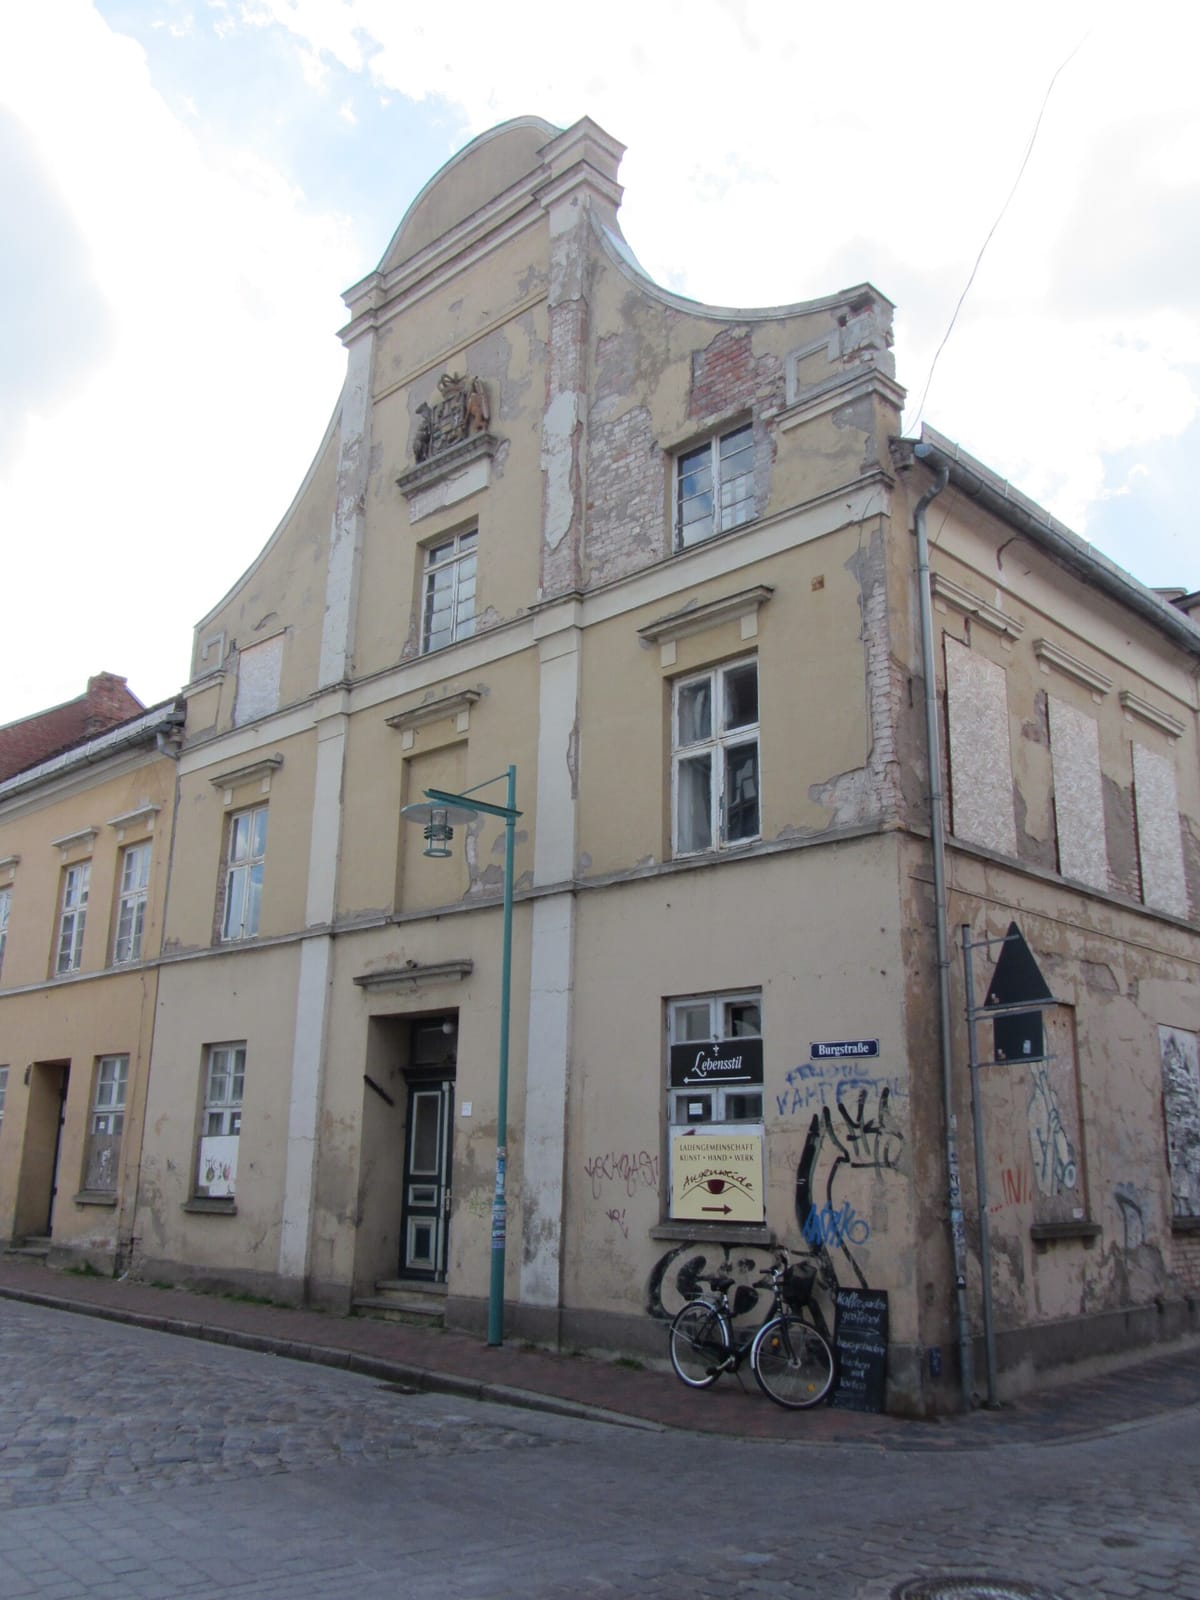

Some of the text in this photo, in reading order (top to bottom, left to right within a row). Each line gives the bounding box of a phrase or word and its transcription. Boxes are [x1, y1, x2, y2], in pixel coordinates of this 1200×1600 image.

[818, 1042, 869, 1056] Burgstraße
[691, 1051, 742, 1077] Lebensstil
[679, 1143, 753, 1152] LADENGEMEINSCHAFT
[683, 1169, 754, 1191] Augenweide
